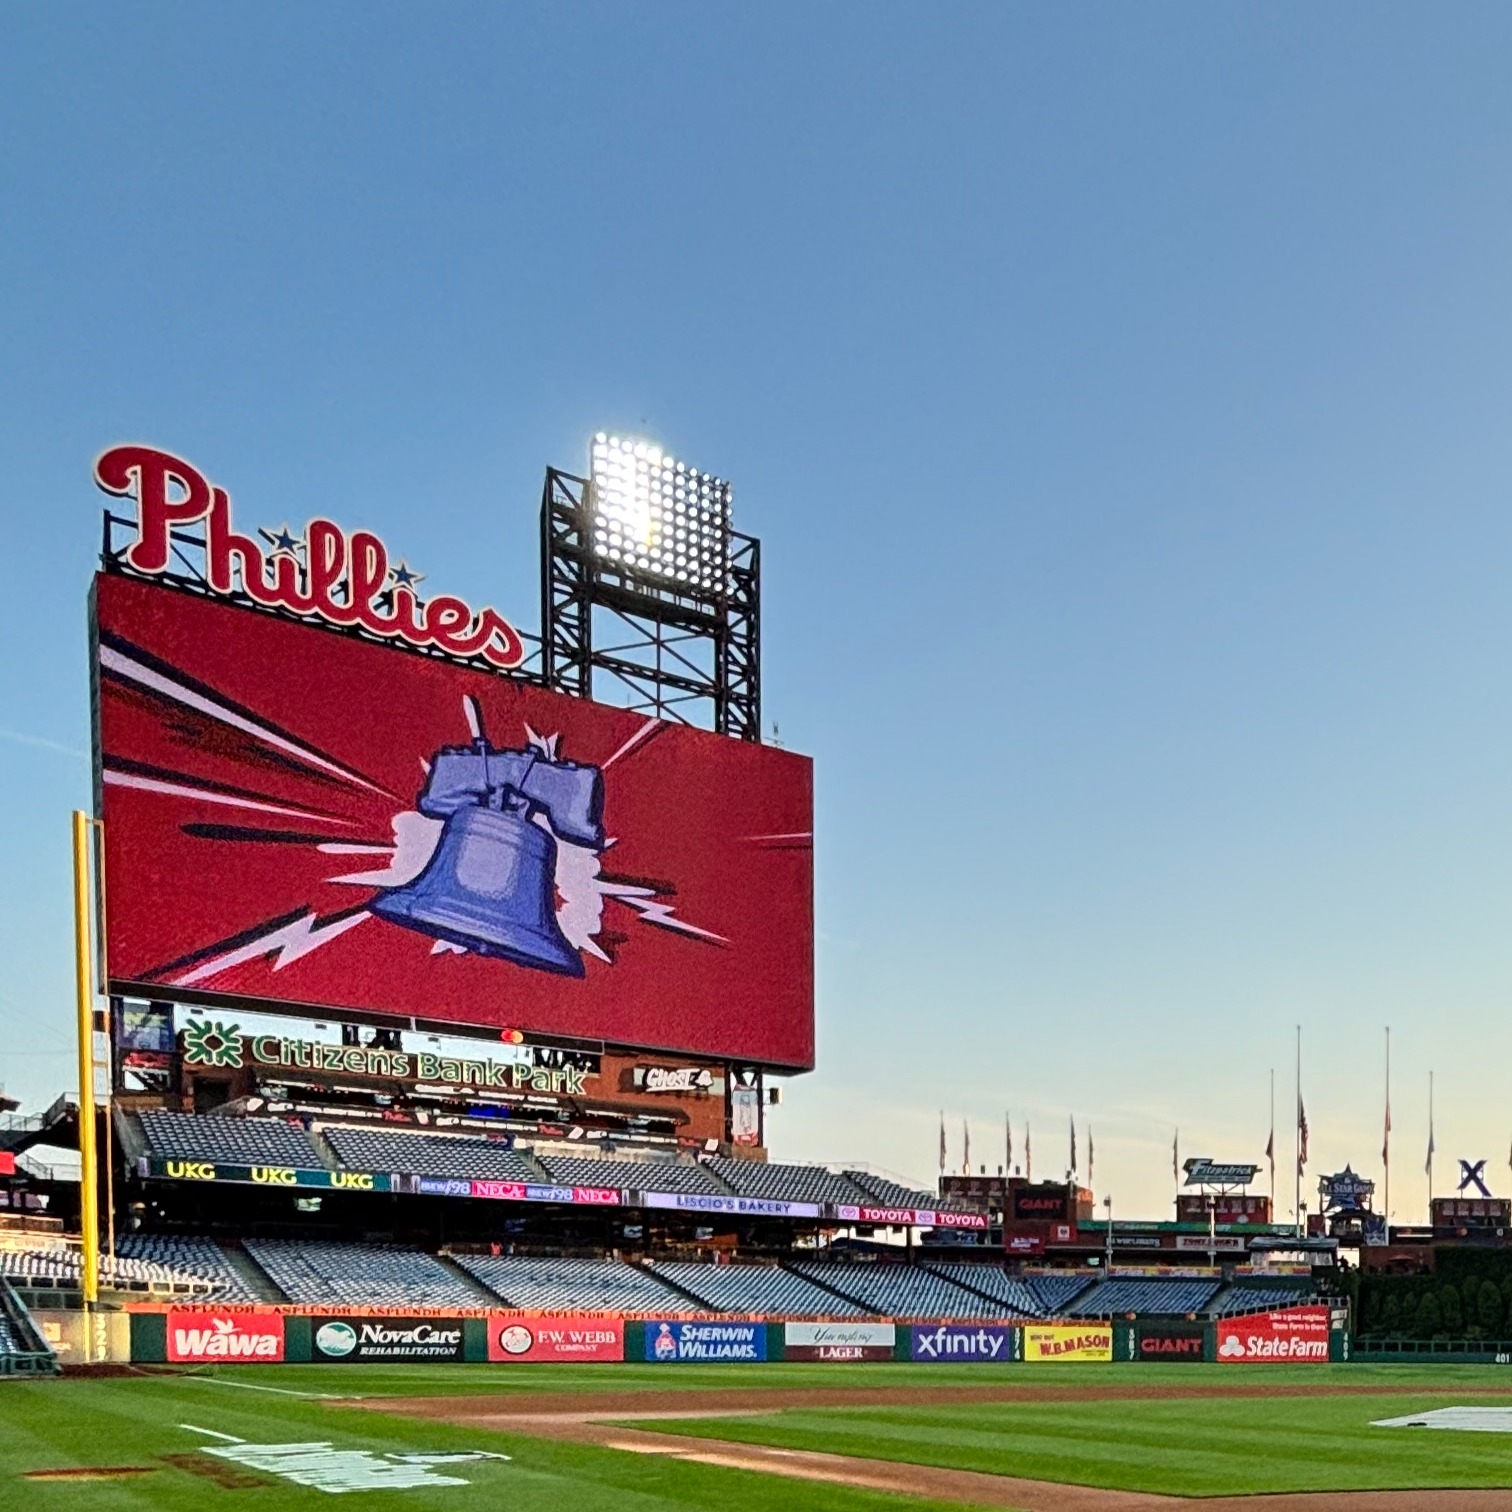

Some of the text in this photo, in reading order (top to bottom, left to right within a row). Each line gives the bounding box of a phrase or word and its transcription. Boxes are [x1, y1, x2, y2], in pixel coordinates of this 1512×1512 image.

[93, 444, 524, 669] Phillies
[252, 1035, 587, 1095] Citizens Bank Park
[646, 1068, 702, 1092] GHOST
[166, 1160, 216, 1180] UKG
[251, 1167, 298, 1185] UKG
[330, 1172, 374, 1190] UKG
[476, 1182, 523, 1198] NECA
[578, 1190, 619, 1204] NECA
[676, 1195, 791, 1214] LISCIO'S BAKERY
[1018, 1199, 1062, 1210] GIANT
[863, 1208, 913, 1222] TOYOTA
[939, 1213, 985, 1226] TOYOTA
[170, 1305, 255, 1314] ASPLUNDH
[273, 1306, 352, 1315] ASPLUNDH
[368, 1306, 441, 1316] ASPLUNDH
[456, 1308, 525, 1317] ASPLUNDH
[540, 1310, 605, 1319] ASPLUNDH
[358, 1324, 461, 1344] NovaCare
[569, 1330, 616, 1343] WEBB
[679, 1324, 755, 1342] SHERWIN
[918, 1327, 1004, 1357] xfinity
[175, 1329, 277, 1356] Wawa
[359, 1346, 458, 1356] REHABILITATION
[1141, 1338, 1202, 1353] GIANT
[1246, 1336, 1328, 1357] StateFarm
[819, 1347, 864, 1359] LAGER
